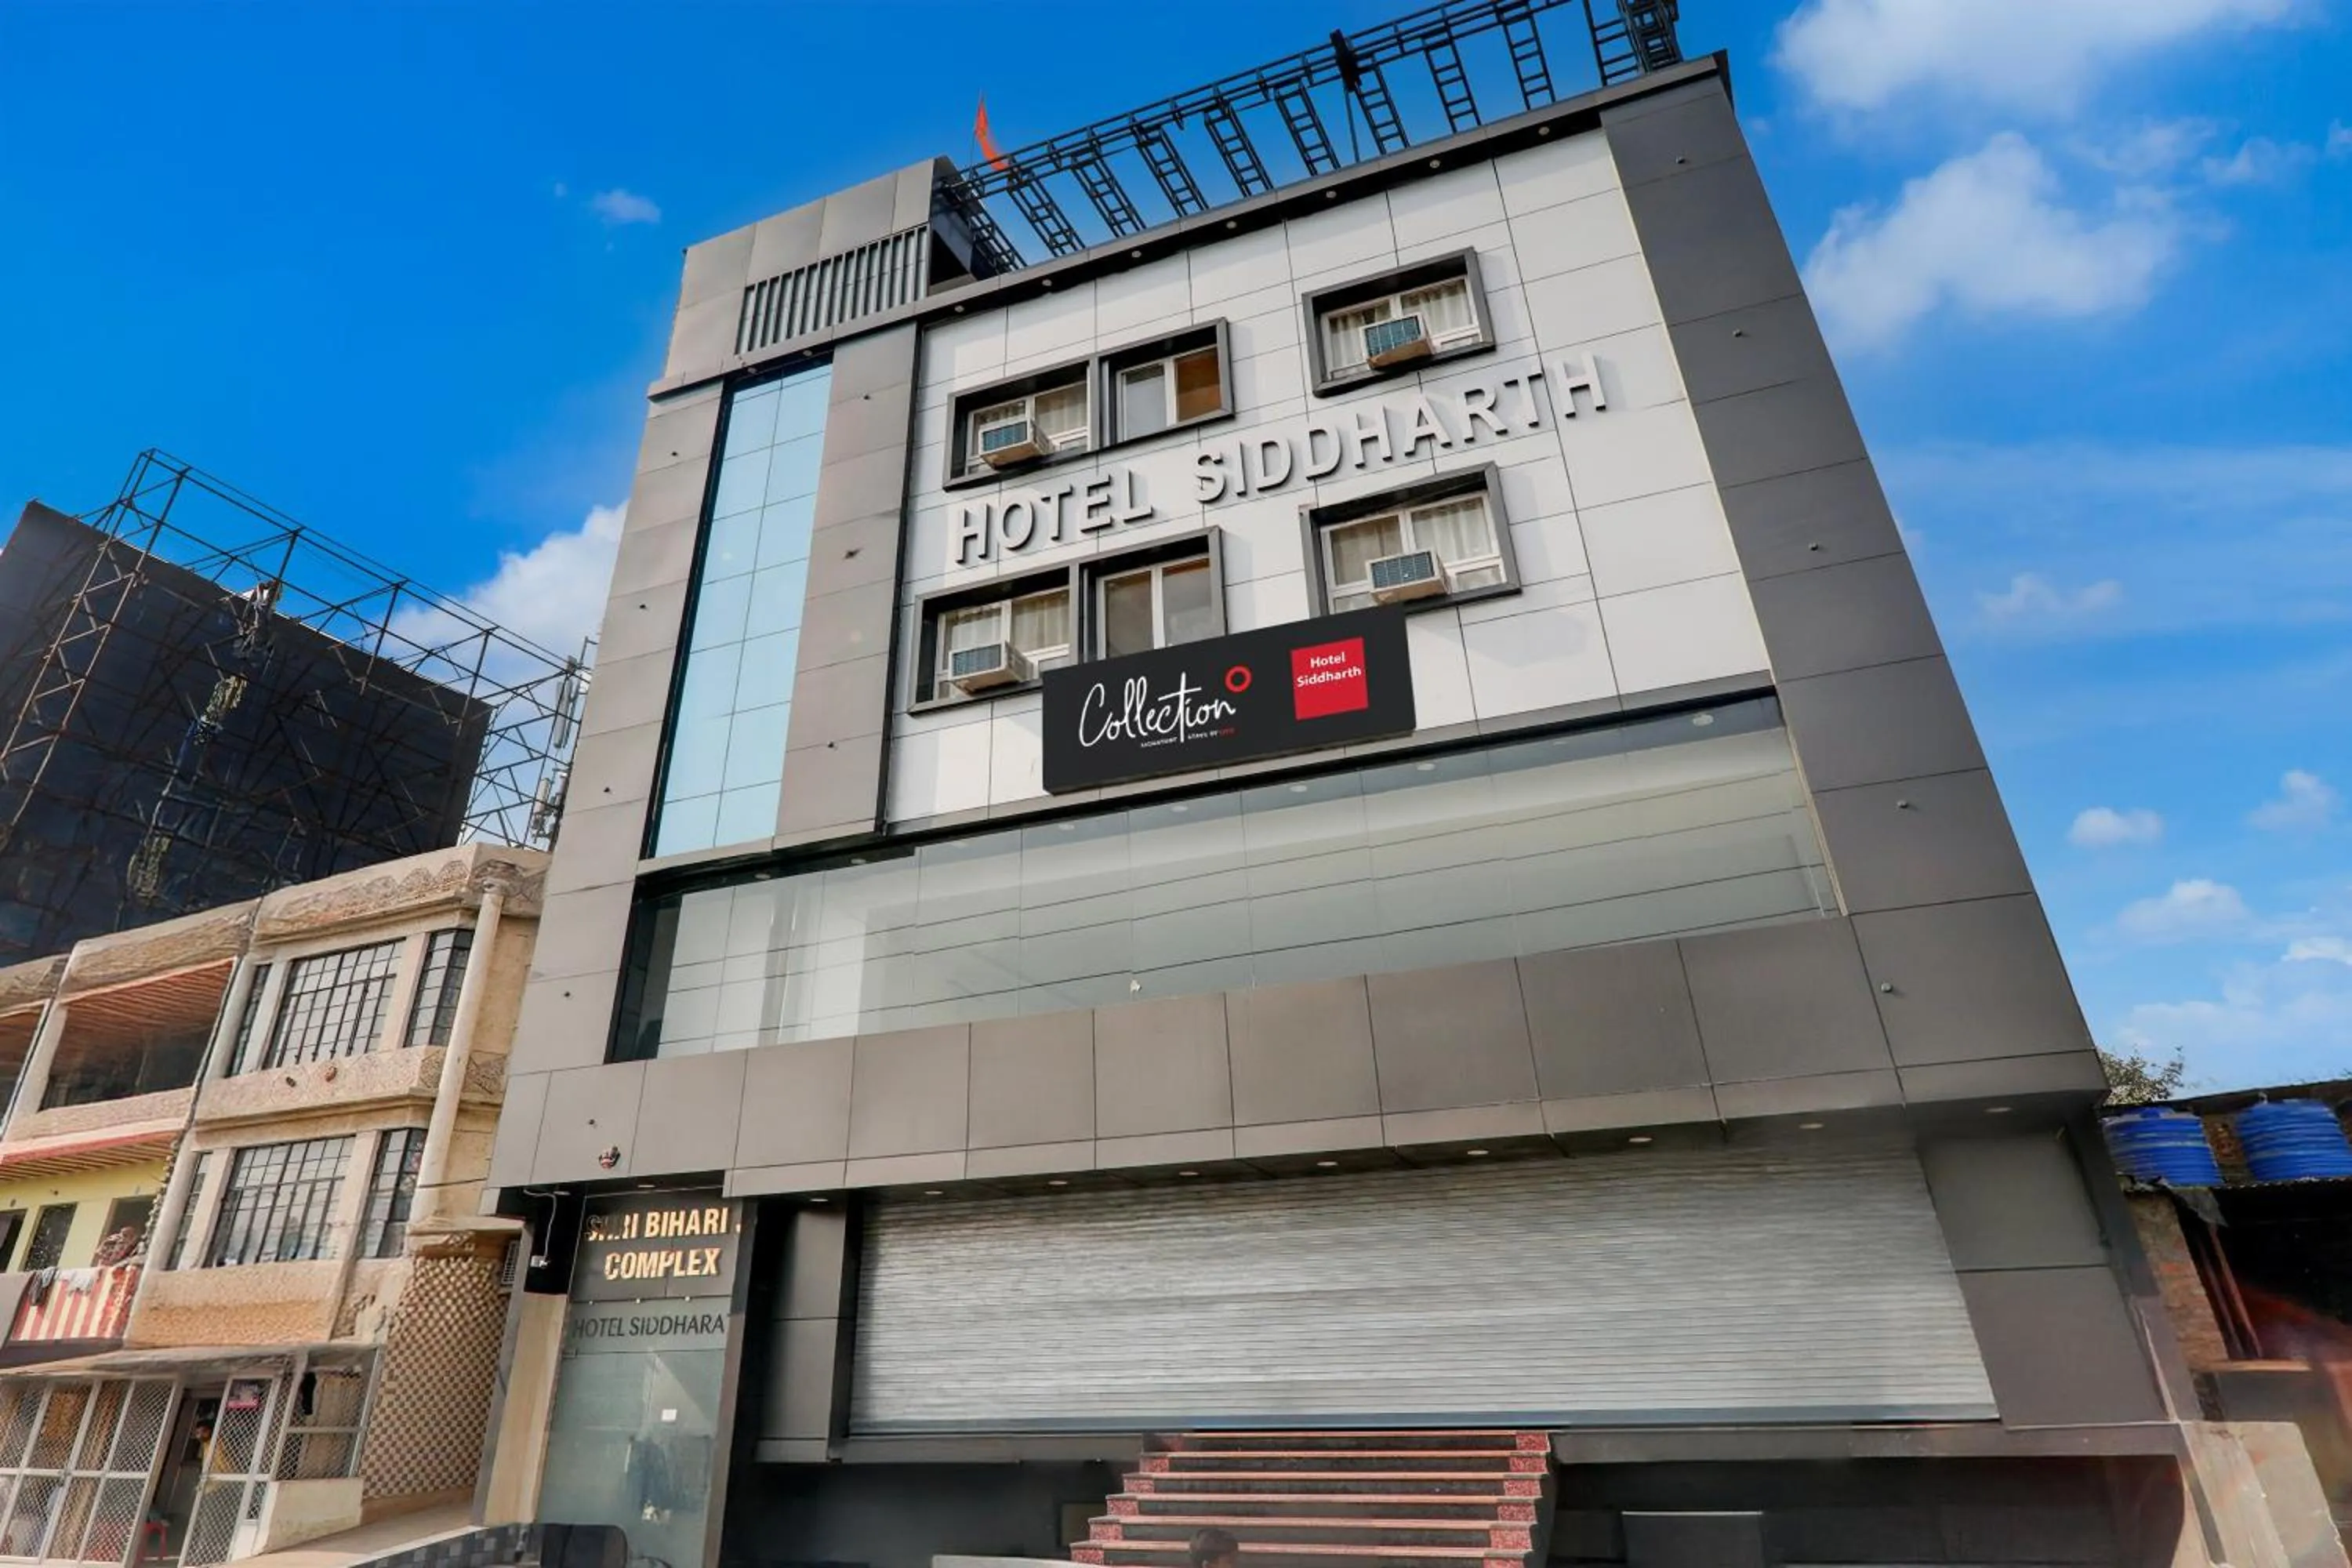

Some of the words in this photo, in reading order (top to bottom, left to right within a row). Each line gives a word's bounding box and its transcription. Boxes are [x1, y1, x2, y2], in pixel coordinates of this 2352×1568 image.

[956, 469, 1156, 564] HOTEL
[1192, 350, 1607, 504] SIDDHARTH
[1309, 651, 1346, 669] Hotel
[1296, 665, 1363, 688] Siddharth
[1079, 672, 1236, 747] Collection
[644, 1207, 729, 1239] BIHARI
[604, 1247, 721, 1280] COMPLEX
[572, 1316, 626, 1338] HOTEL
